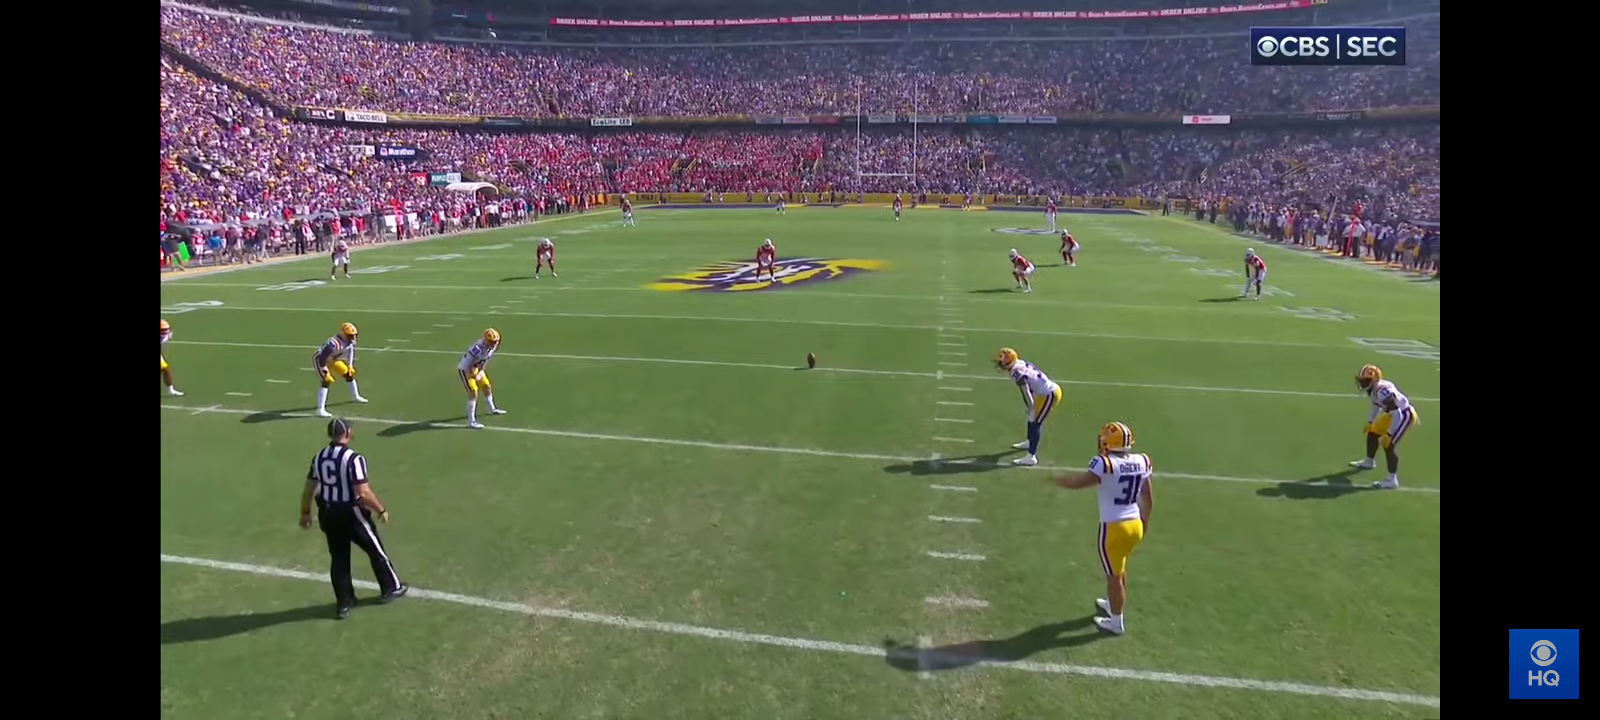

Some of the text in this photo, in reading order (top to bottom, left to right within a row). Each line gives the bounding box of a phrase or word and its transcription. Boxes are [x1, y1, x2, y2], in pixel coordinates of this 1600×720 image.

[357, 113, 385, 122] TACO BELL
[388, 147, 416, 156] Marathon
[321, 459, 338, 485] C
[1114, 474, 1142, 506] 31
